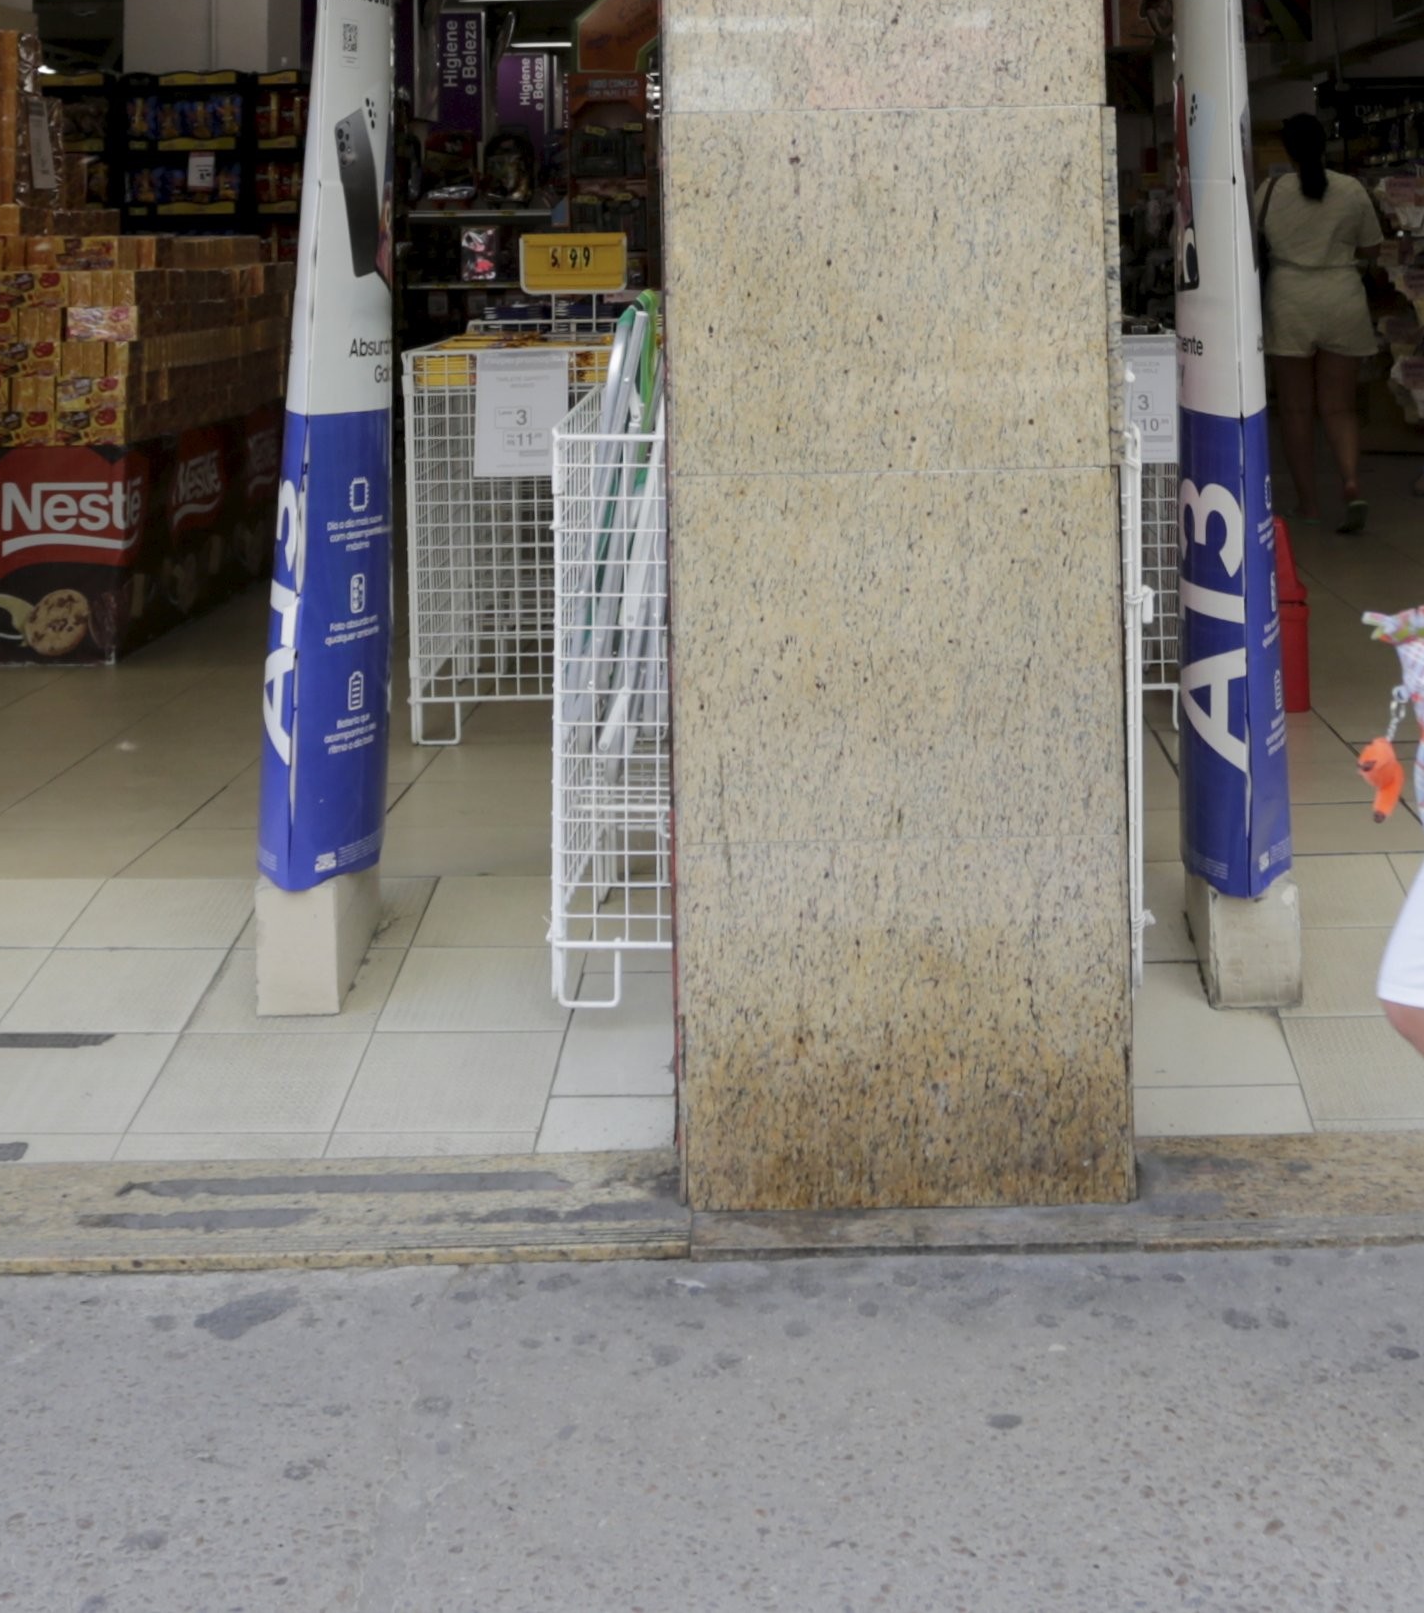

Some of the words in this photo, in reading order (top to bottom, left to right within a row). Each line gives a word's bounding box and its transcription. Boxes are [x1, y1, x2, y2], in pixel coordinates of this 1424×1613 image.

[443, 19, 461, 87] Higiene
[462, 19, 477, 82] Beleza
[465, 85, 477, 96] e
[519, 57, 534, 106] Higiene
[532, 57, 544, 100] Beleza
[516, 409, 527, 426] 3
[1137, 393, 1149, 411] 3
[1, 476, 143, 533] Nestlé
